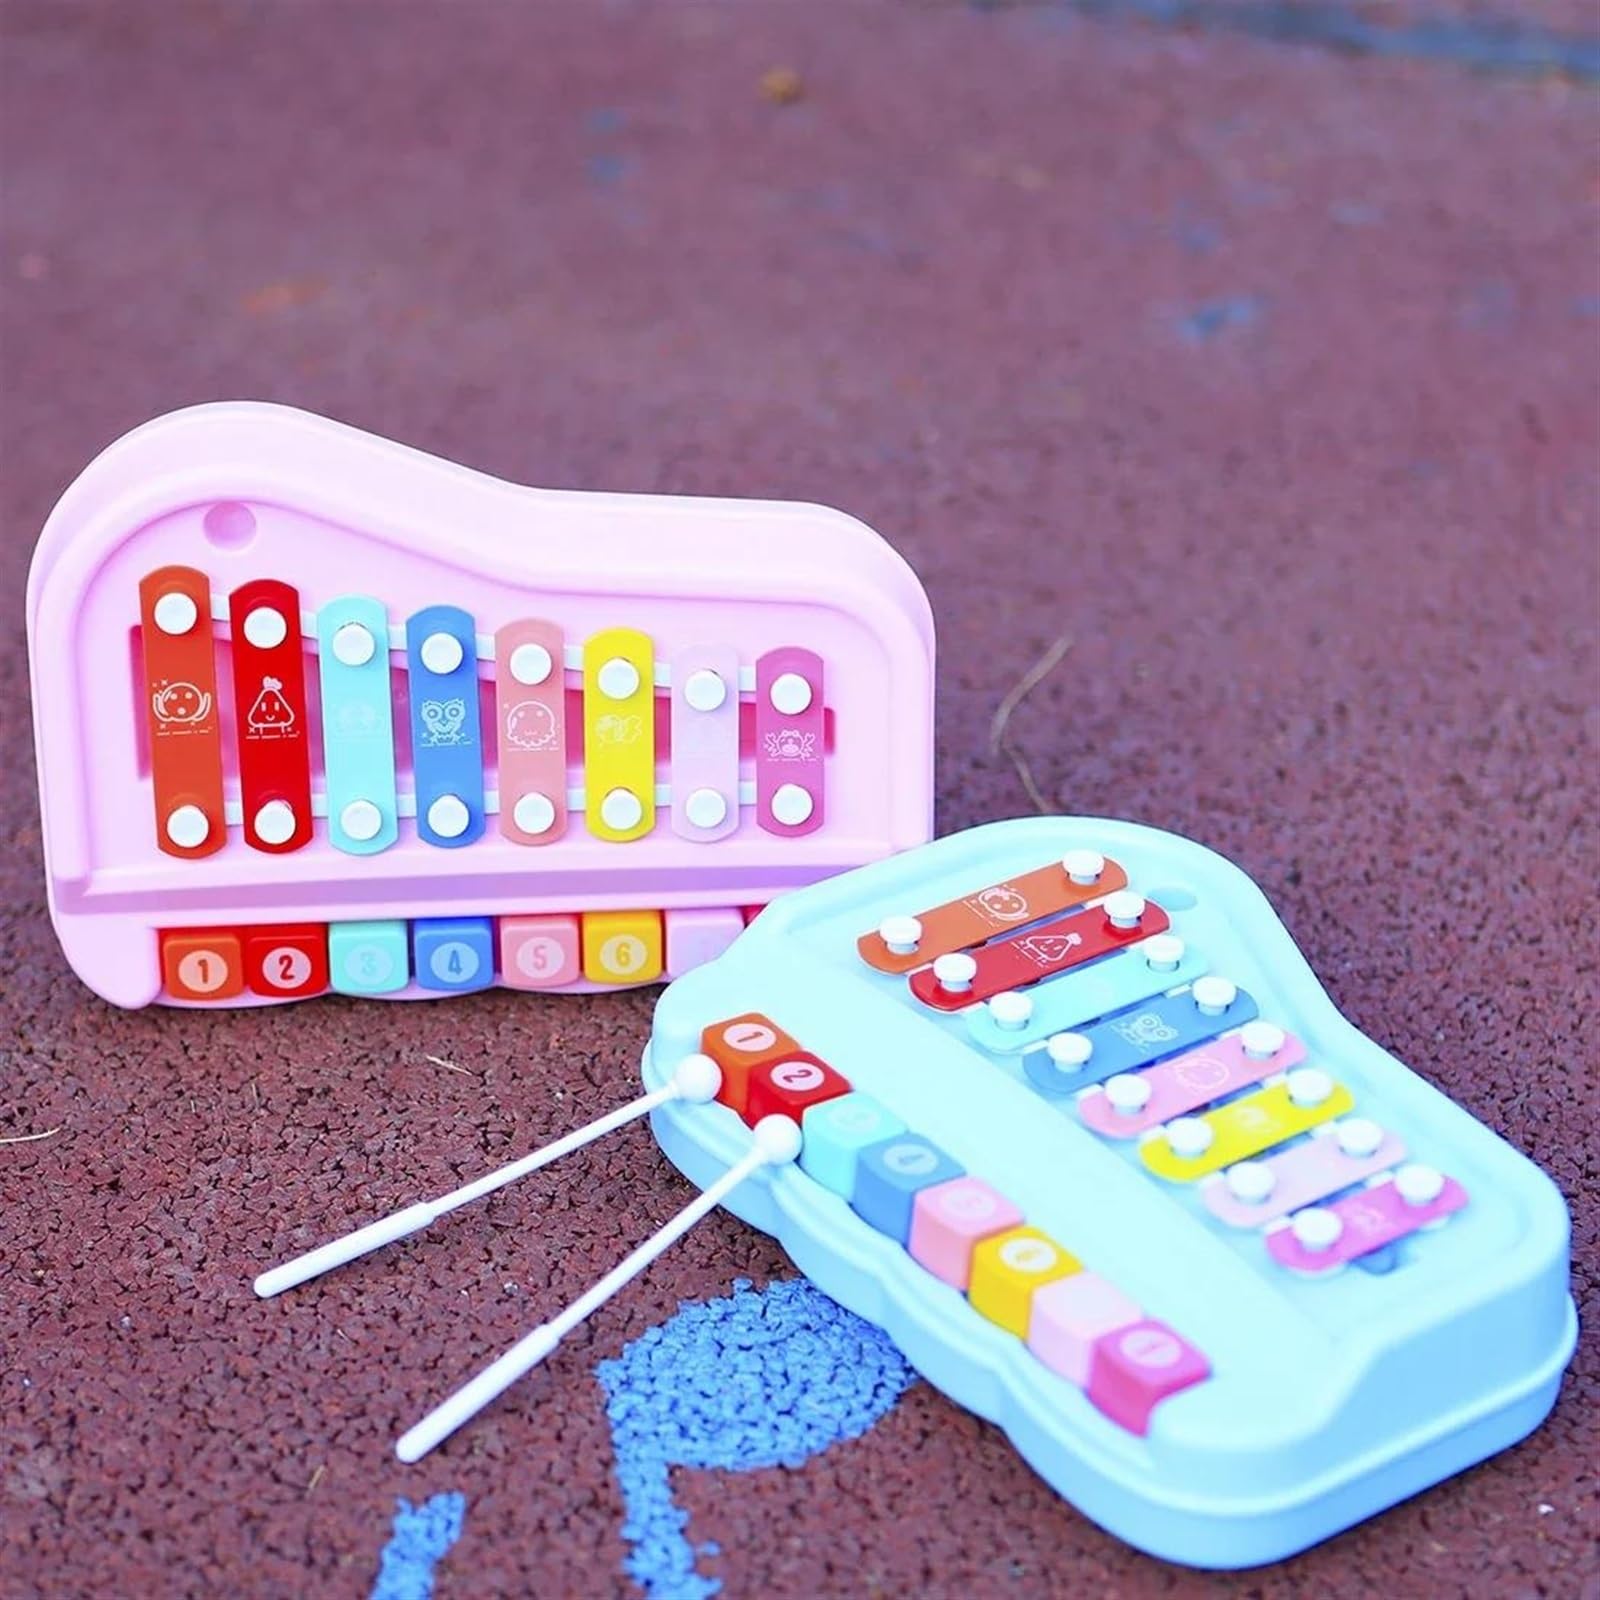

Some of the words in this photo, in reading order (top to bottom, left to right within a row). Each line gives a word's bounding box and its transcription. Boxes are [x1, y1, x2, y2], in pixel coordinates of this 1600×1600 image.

[278, 954, 295, 980] 2
[448, 949, 463, 975] 4
[533, 945, 547, 970] 5
[615, 942, 631, 967] 6
[197, 958, 209, 984] 1
[737, 1031, 764, 1043] 1
[783, 1069, 813, 1084] 2
